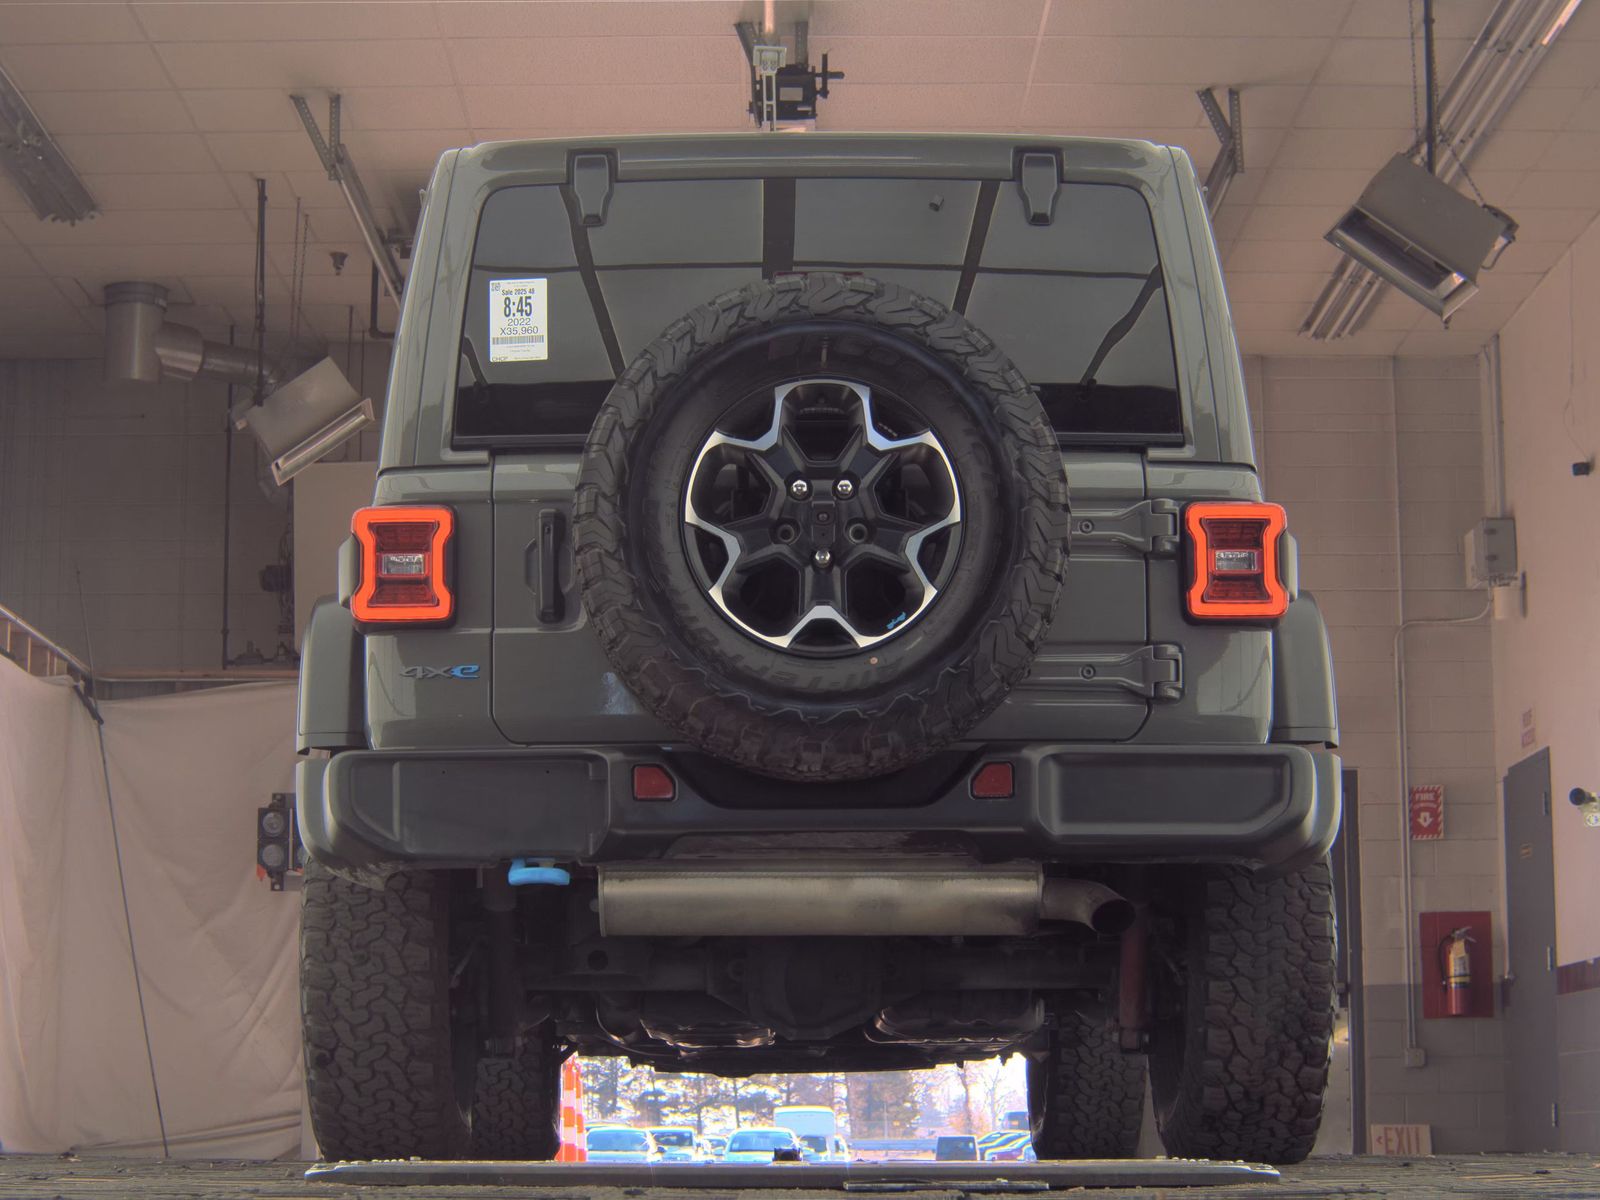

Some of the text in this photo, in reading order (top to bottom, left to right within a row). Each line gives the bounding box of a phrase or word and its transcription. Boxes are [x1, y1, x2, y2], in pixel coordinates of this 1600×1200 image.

[503, 295, 533, 318] 8:45
[507, 318, 531, 326] 2022
[1415, 792, 1436, 801] FIRE
[1384, 1126, 1420, 1154] EXIT
